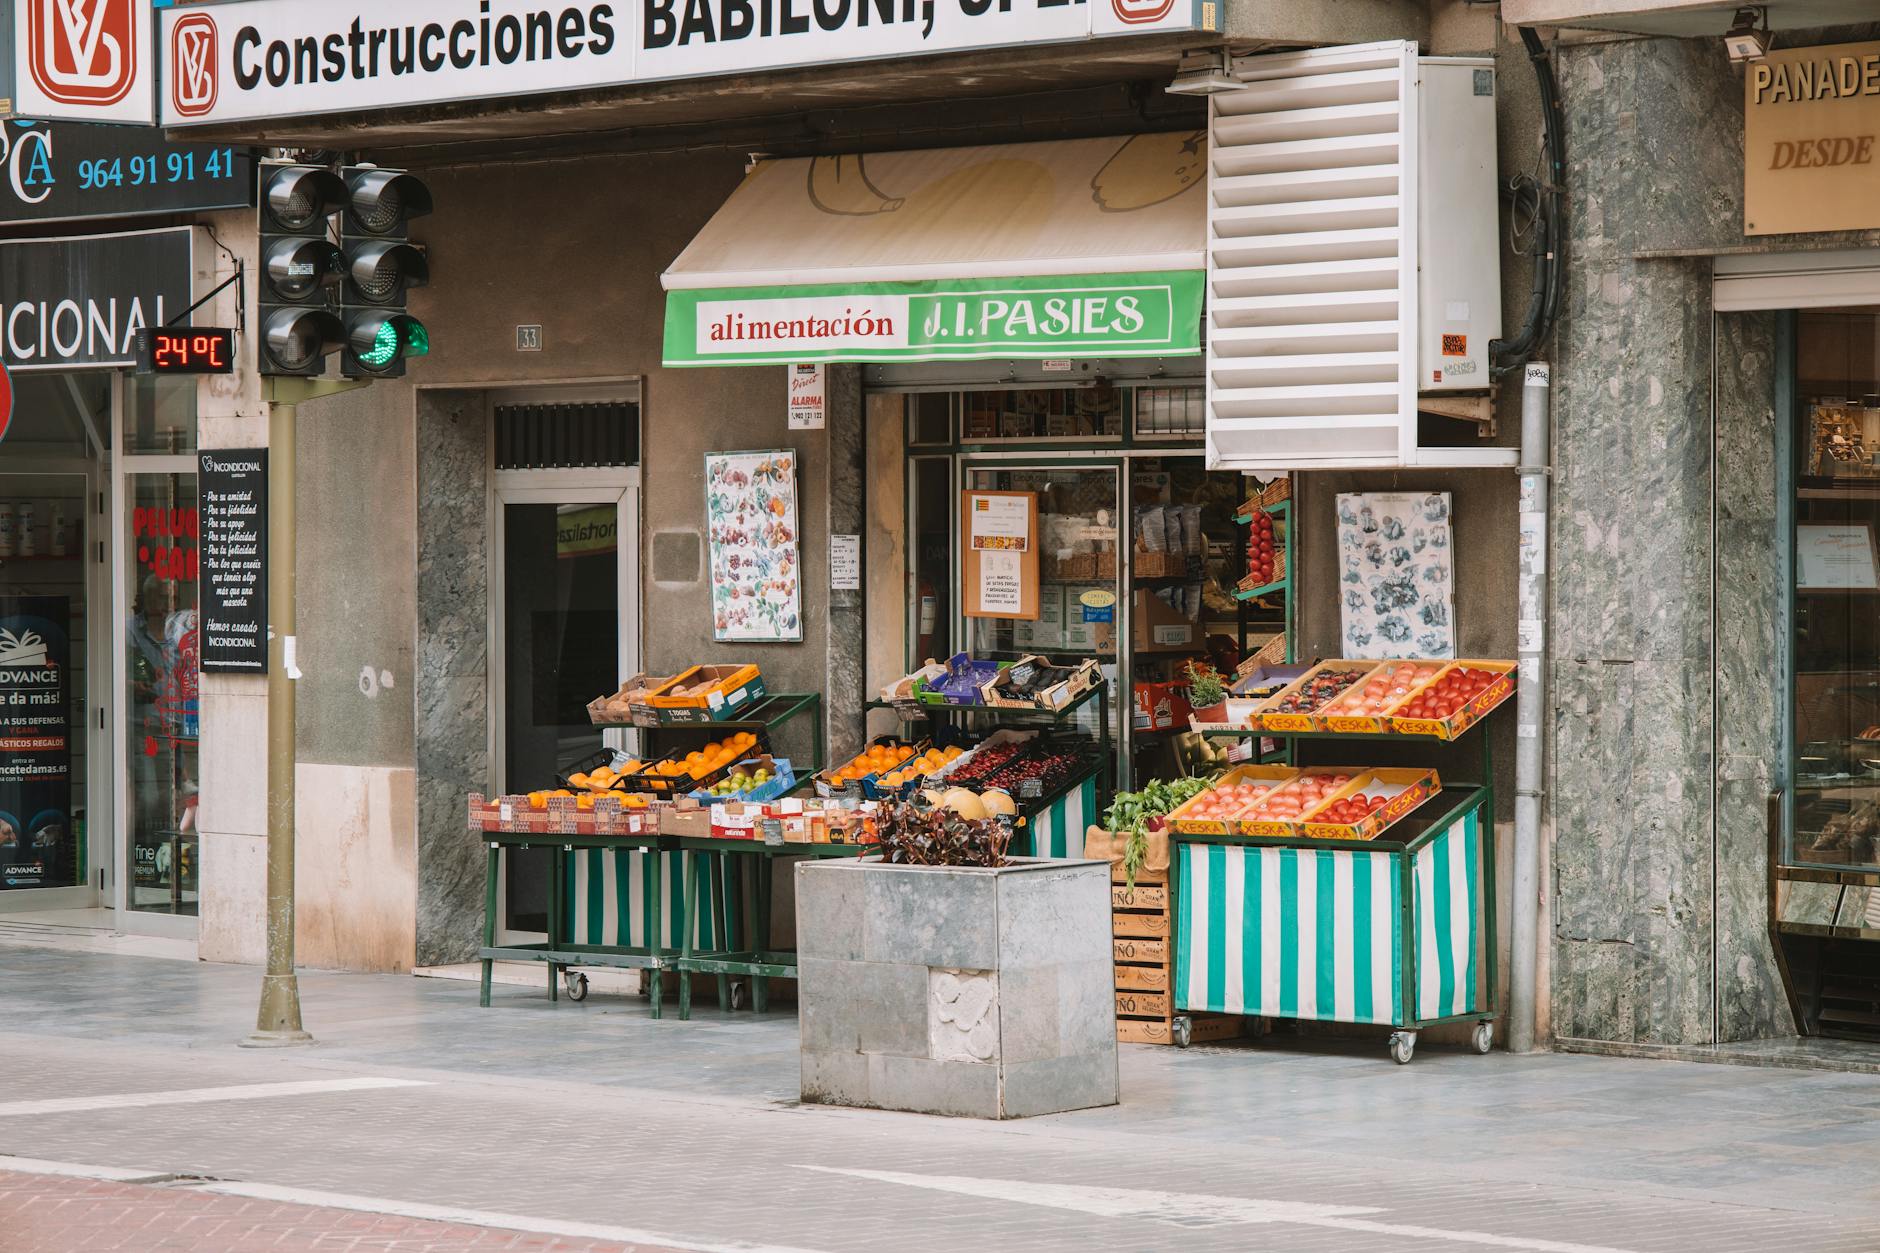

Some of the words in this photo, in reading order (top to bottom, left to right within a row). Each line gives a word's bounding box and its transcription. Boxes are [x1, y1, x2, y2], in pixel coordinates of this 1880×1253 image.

[233, 0, 615, 90] Construcciones
[1755, 55, 1880, 104] PANADE
[1769, 136, 1875, 170] DESDE
[79, 158, 123, 189] 964
[131, 155, 157, 185] 91
[167, 151, 195, 182] 91
[205, 148, 233, 178] 41
[710, 308, 894, 342] alimentación
[522, 328, 537, 348] 33
[791, 396, 822, 405] ALARMA
[207, 618, 230, 632] Hemos
[232, 620, 258, 633] creado
[208, 636, 256, 648] INCONDICIONAL
[9, 692, 26, 705] da
[30, 691, 60, 704] más!
[1475, 681, 1509, 714] XESKA
[1265, 718, 1307, 730] XESKA
[1331, 718, 1374, 730] XESKA
[1396, 722, 1440, 733] XESKA
[32, 738, 64, 748] REGALOS
[1385, 788, 1421, 820] XESKA
[1180, 823, 1222, 834] XESKA
[1243, 825, 1286, 836] XESKA
[1308, 827, 1350, 839] XESKA
[5, 866, 42, 874] ADVANCE
[1114, 942, 1136, 958] ÑÓ
[1116, 996, 1136, 1012] ÑÓ
